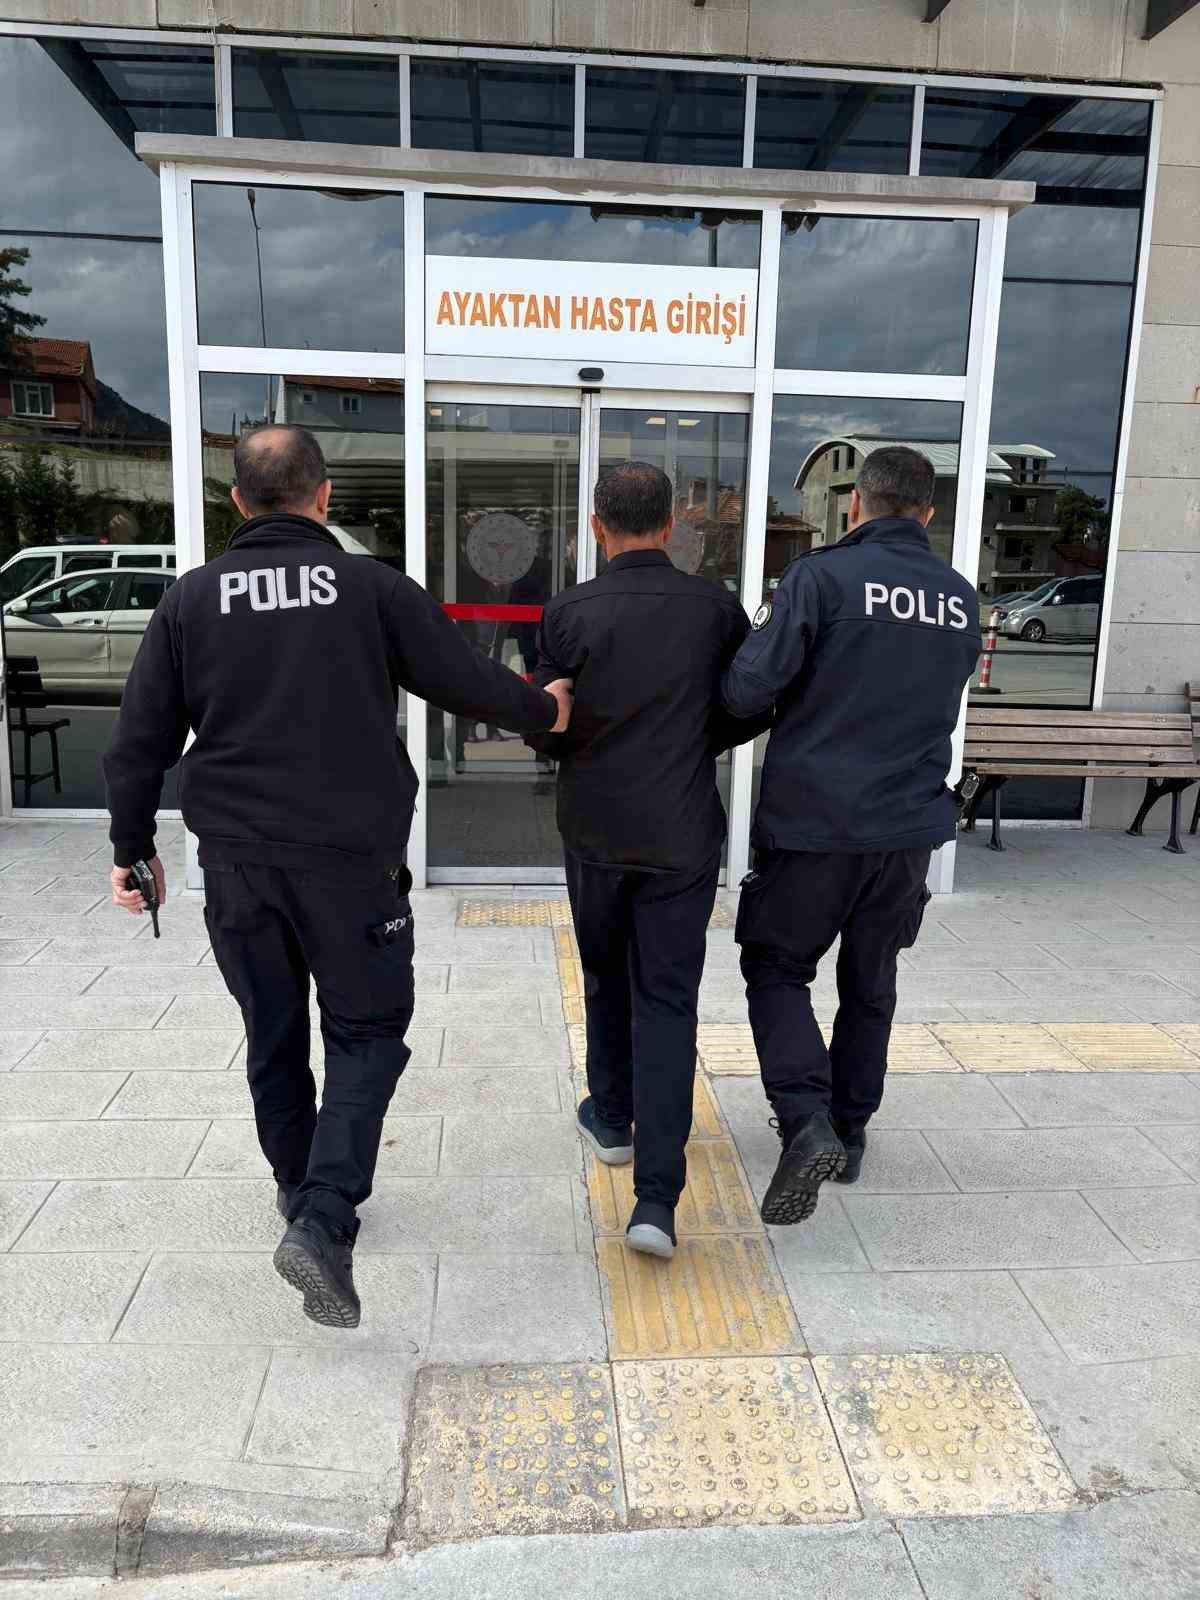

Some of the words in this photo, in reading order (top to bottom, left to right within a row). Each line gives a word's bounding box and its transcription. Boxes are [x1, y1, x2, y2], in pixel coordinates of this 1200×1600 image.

[436, 291, 561, 329] AYAKTAN
[570, 296, 658, 333] HASTA
[666, 292, 746, 344] GİRİŞİ
[220, 565, 338, 615] POLIS
